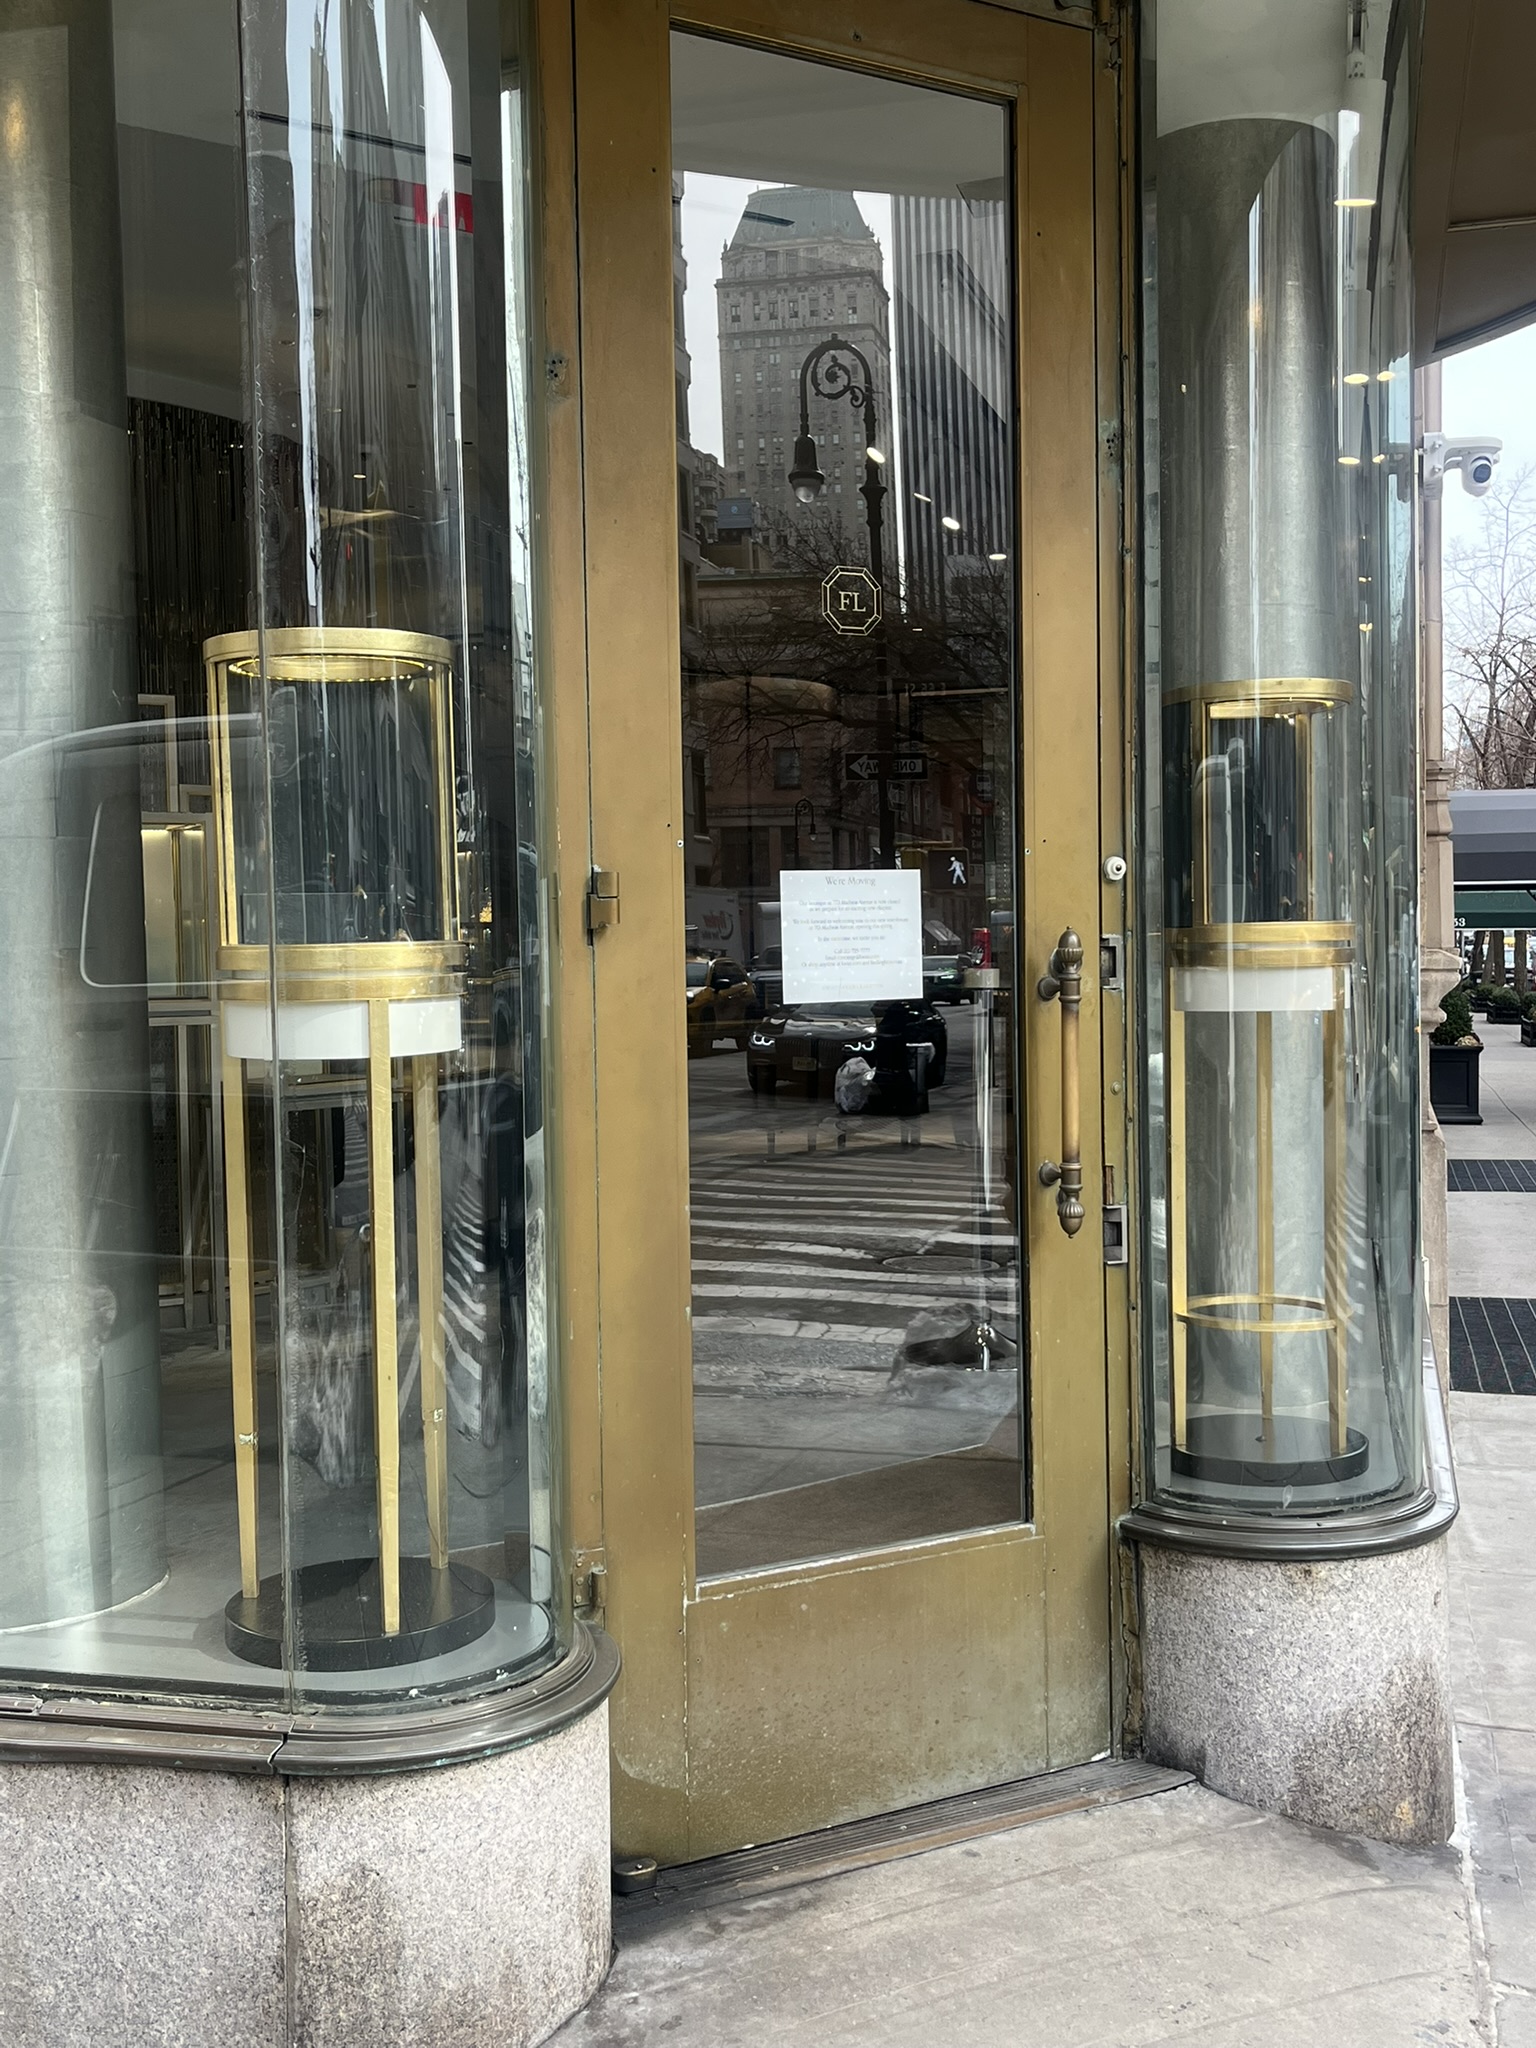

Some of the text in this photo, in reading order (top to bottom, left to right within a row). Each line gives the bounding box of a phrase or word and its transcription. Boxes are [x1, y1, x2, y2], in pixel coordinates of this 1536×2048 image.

[838, 590, 867, 612] FL
[825, 876, 876, 887] We're Moving
